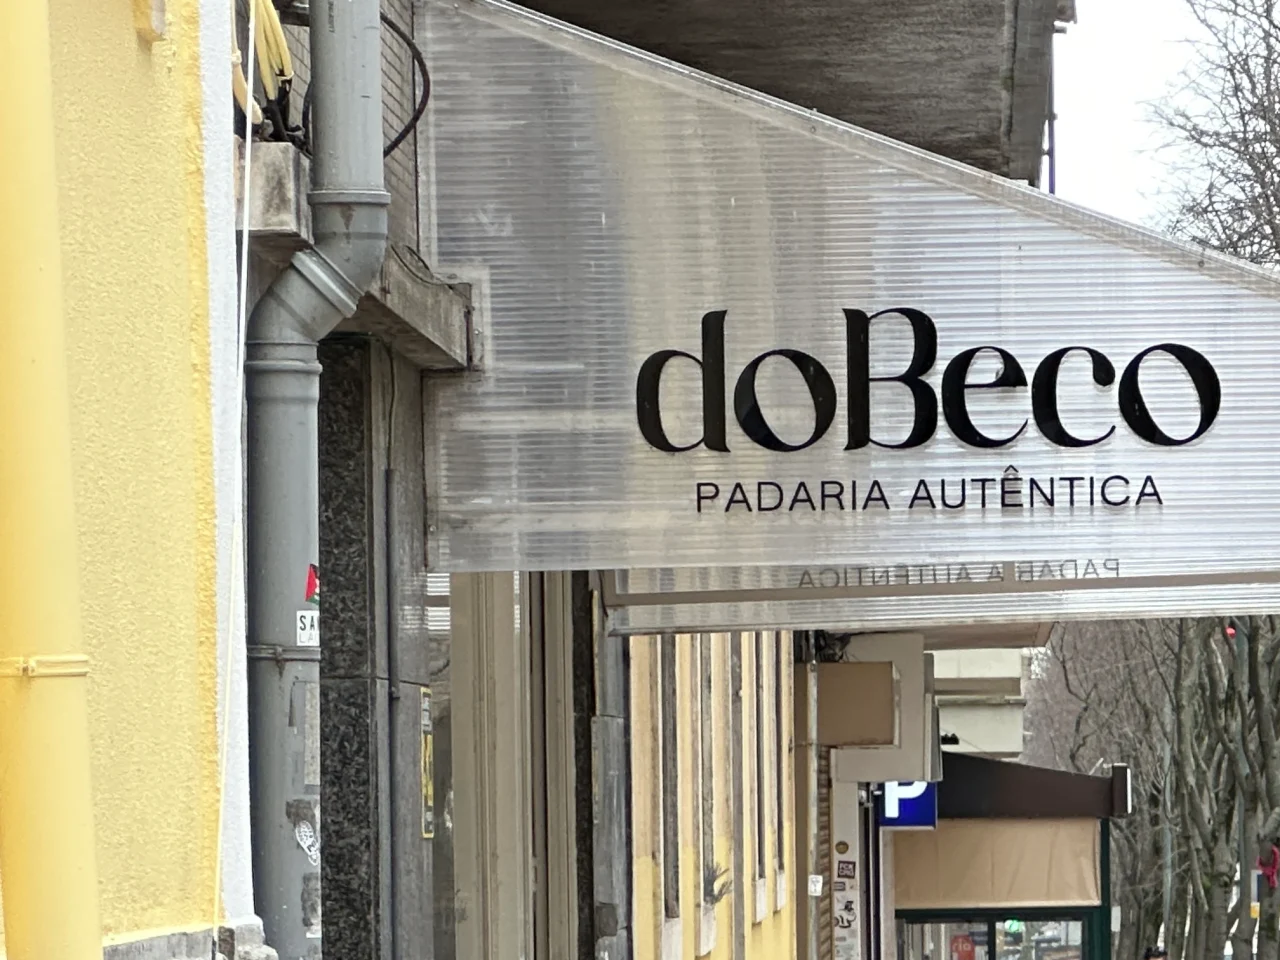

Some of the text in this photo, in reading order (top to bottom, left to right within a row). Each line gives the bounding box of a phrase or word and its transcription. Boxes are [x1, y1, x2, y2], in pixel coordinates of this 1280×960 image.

[637, 307, 1221, 453] doBeco
[696, 465, 1164, 513] PADARIA AUTÊNTICA
[299, 614, 320, 631] SA
[884, 780, 928, 818] P
